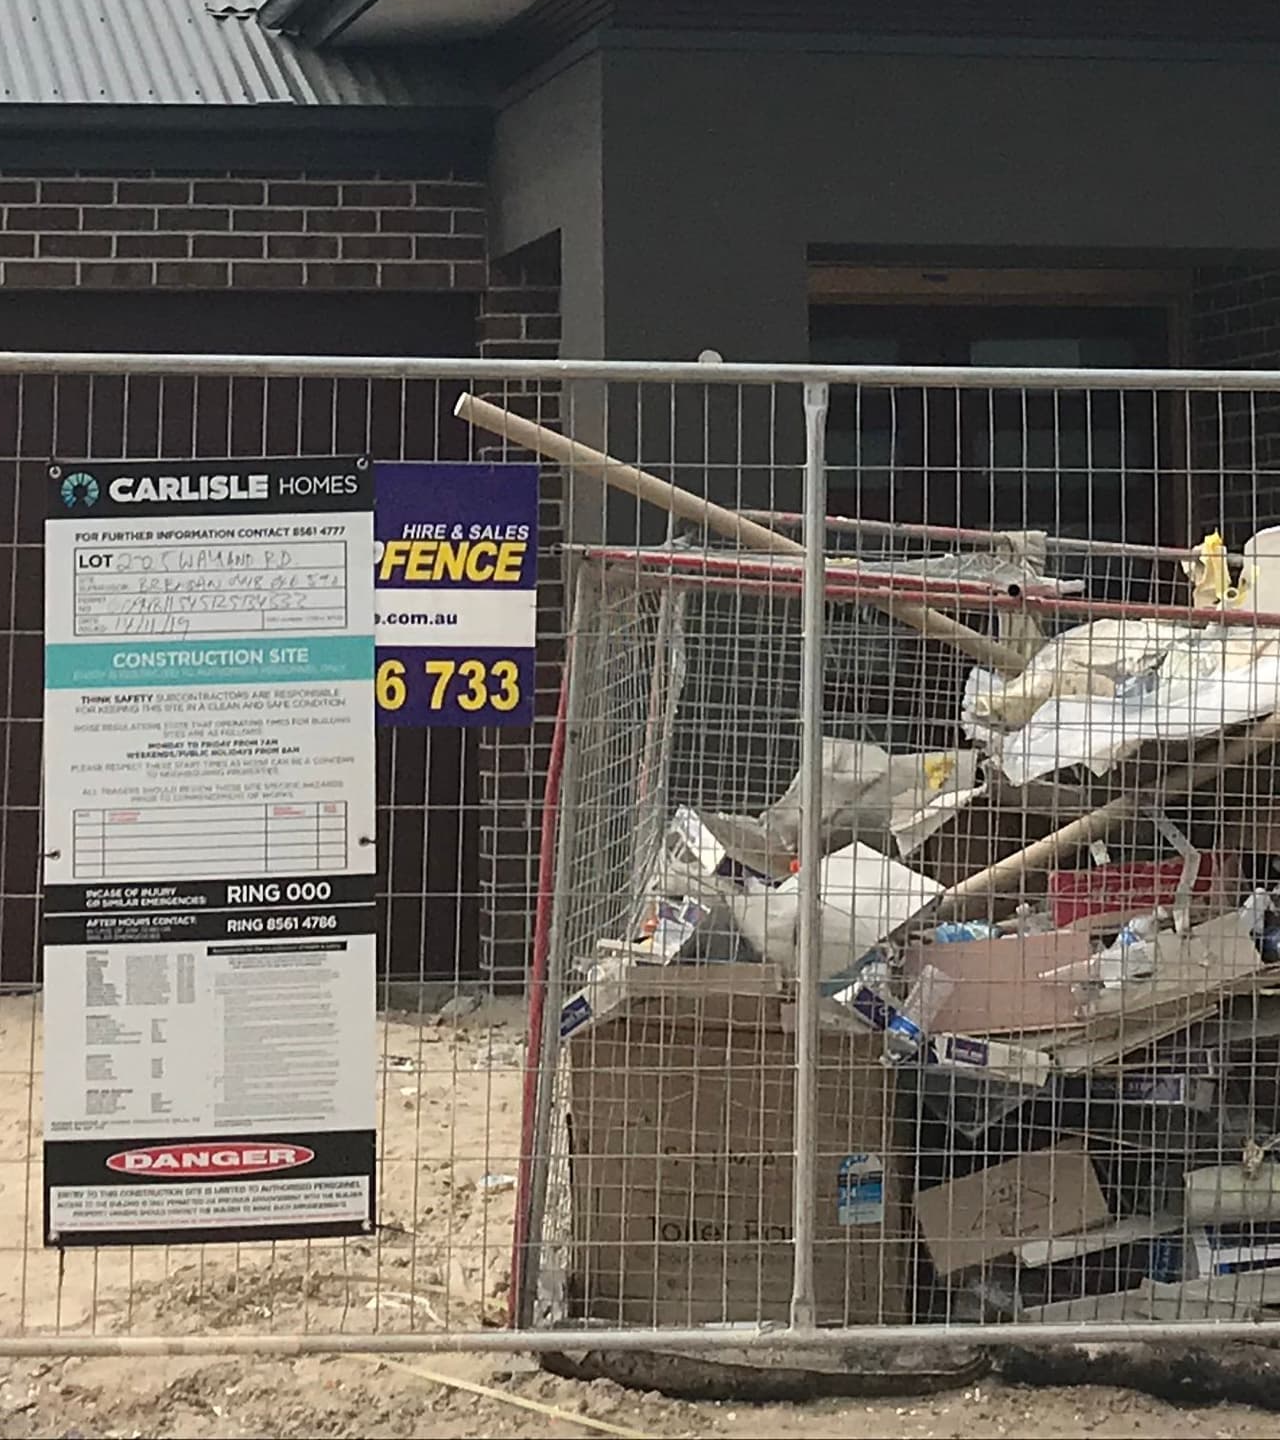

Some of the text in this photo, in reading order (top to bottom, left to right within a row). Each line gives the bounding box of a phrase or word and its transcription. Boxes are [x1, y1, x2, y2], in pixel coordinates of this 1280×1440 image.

[109, 474, 359, 502] CARLISLE HOMES
[75, 525, 346, 543] FOR FURTHER INFORMATION CONTACT 8561 4777
[402, 523, 530, 540] HIRE & SALES
[78, 554, 113, 569] LOT
[112, 647, 310, 668] CONSTRUCTION SITE
[376, 659, 520, 710] 6 733
[81, 695, 111, 705] THINK
[114, 694, 154, 704] SAFETY
[227, 881, 332, 904] RING 000
[86, 917, 116, 928] AFTER
[227, 918, 264, 933] RING
[266, 916, 299, 931] 8561
[125, 1148, 297, 1169] DANGER
